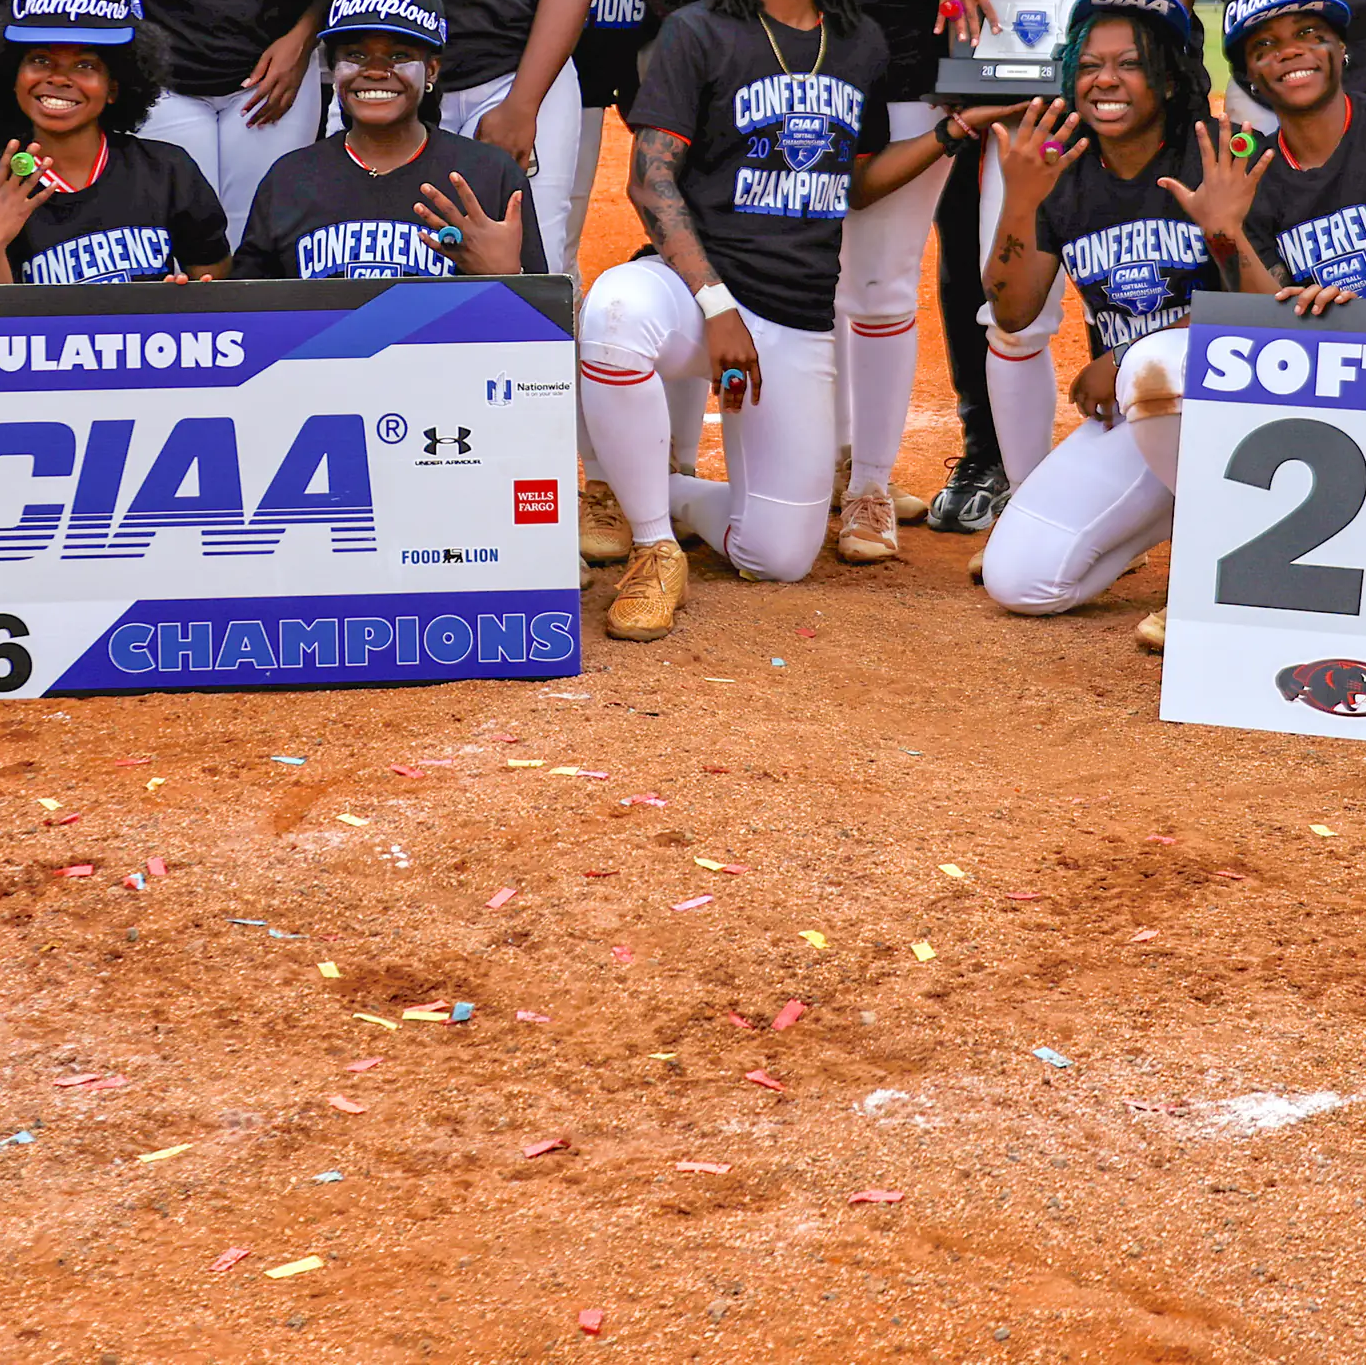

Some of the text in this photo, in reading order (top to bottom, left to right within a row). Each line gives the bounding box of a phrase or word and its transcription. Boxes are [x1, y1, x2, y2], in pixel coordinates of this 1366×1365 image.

[1242, 0, 1324, 28] CIAA
[982, 66, 1053, 77] 20 26
[734, 72, 866, 134] CONFERENCE
[789, 118, 823, 132] CIAA
[747, 136, 771, 160] 20
[782, 138, 826, 147] CHAMPIONSHIP
[735, 168, 852, 218] CHAMPIONS
[1062, 219, 1210, 284] CONFERENCE
[1115, 266, 1150, 282] CIAA
[1322, 258, 1361, 281] CIAA
[1112, 285, 1162, 300] CHAMPIONSHIP
[1121, 282, 1148, 291] SOFTBALL
[517, 381, 571, 392] Nationwide
[517, 491, 554, 501] WELLS
[518, 503, 555, 512] FARGO
[402, 548, 499, 564] FOOD LION
[108, 612, 574, 673] CHAMPIONS
